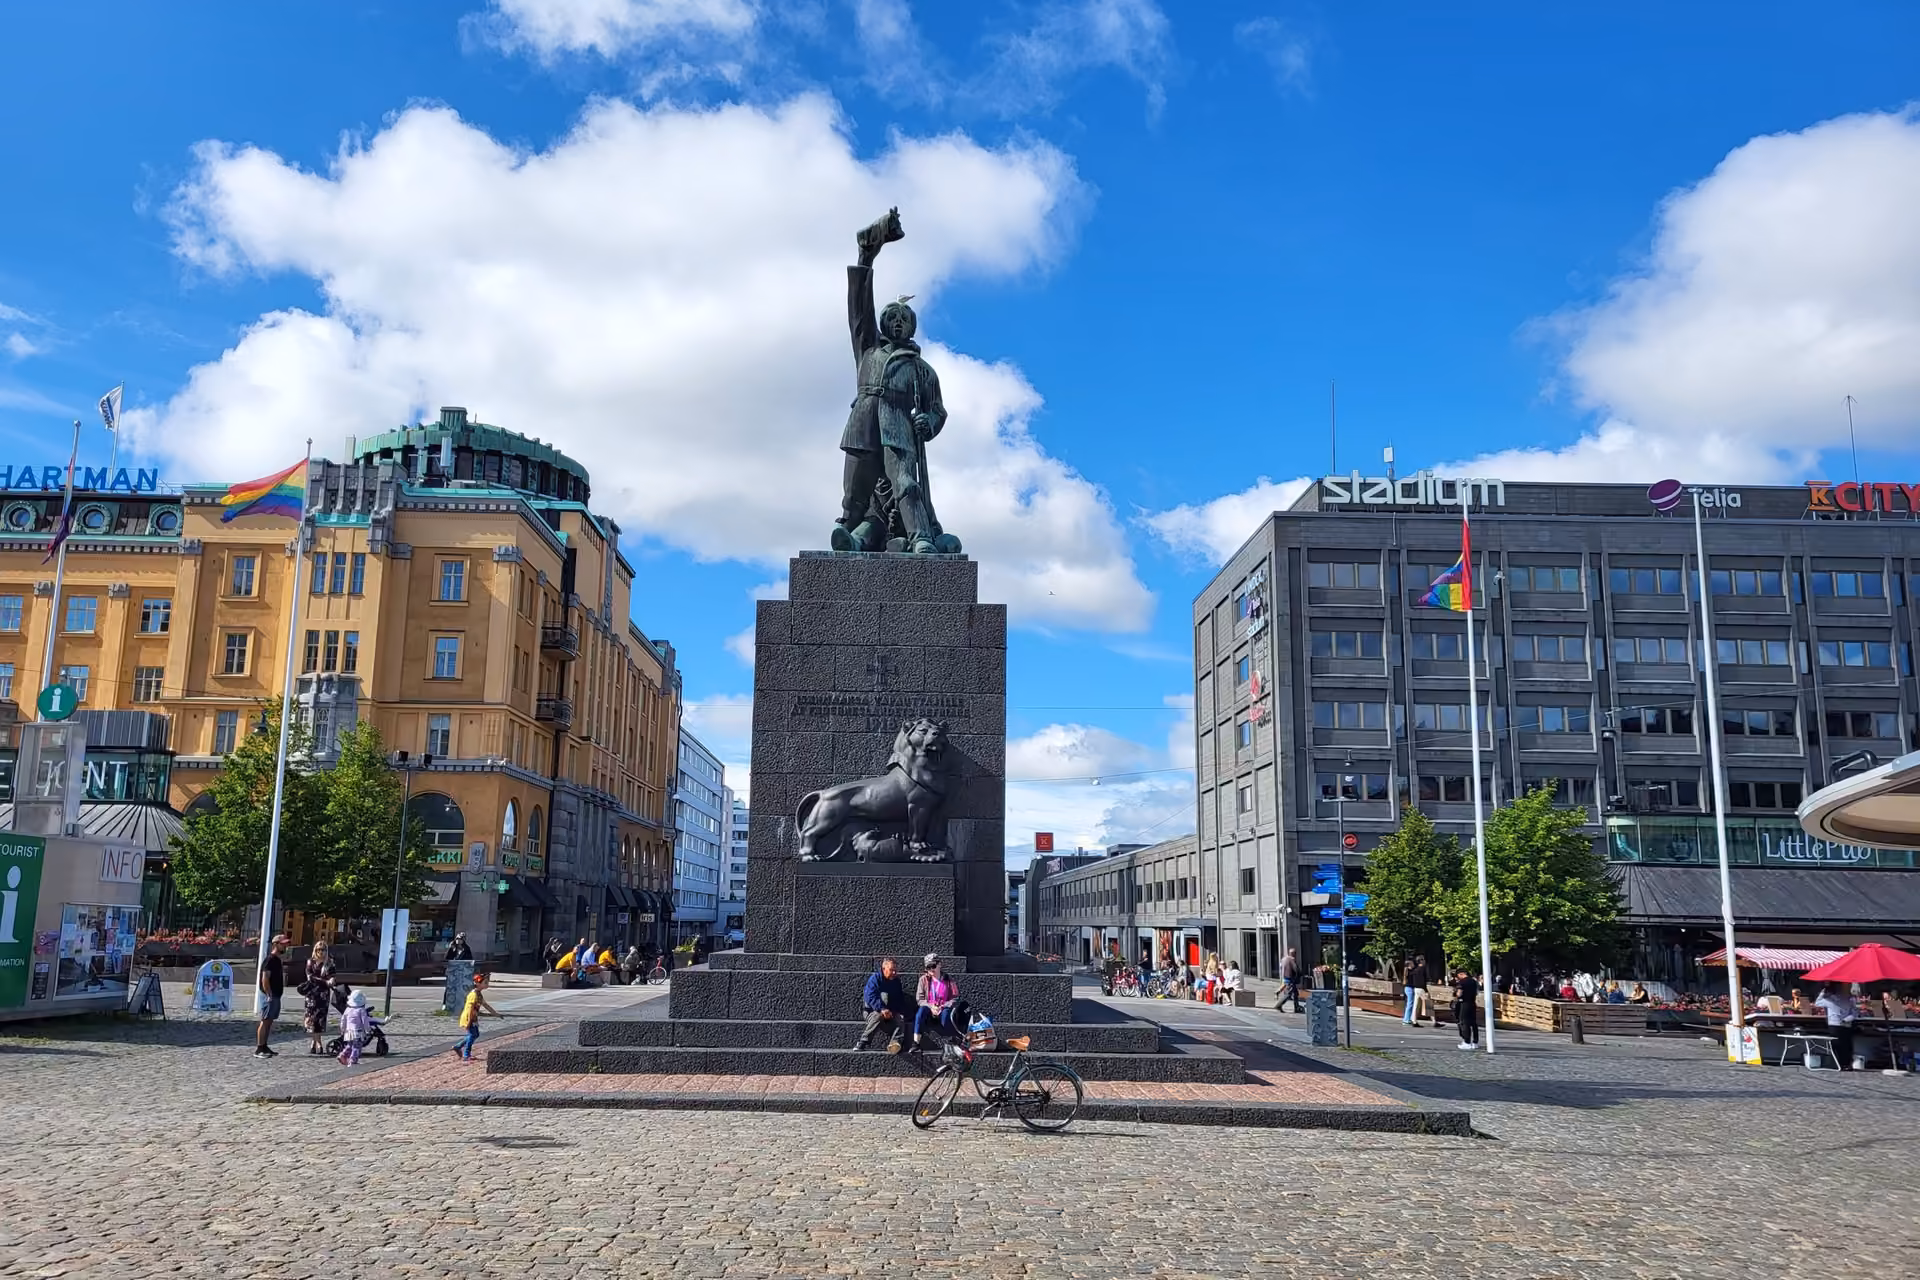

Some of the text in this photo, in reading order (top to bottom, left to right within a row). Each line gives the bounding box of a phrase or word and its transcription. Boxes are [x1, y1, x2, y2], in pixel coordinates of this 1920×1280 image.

[1323, 470, 1505, 506] stadium
[0, 843, 40, 858] OURIST
[101, 848, 143, 880] INFO
